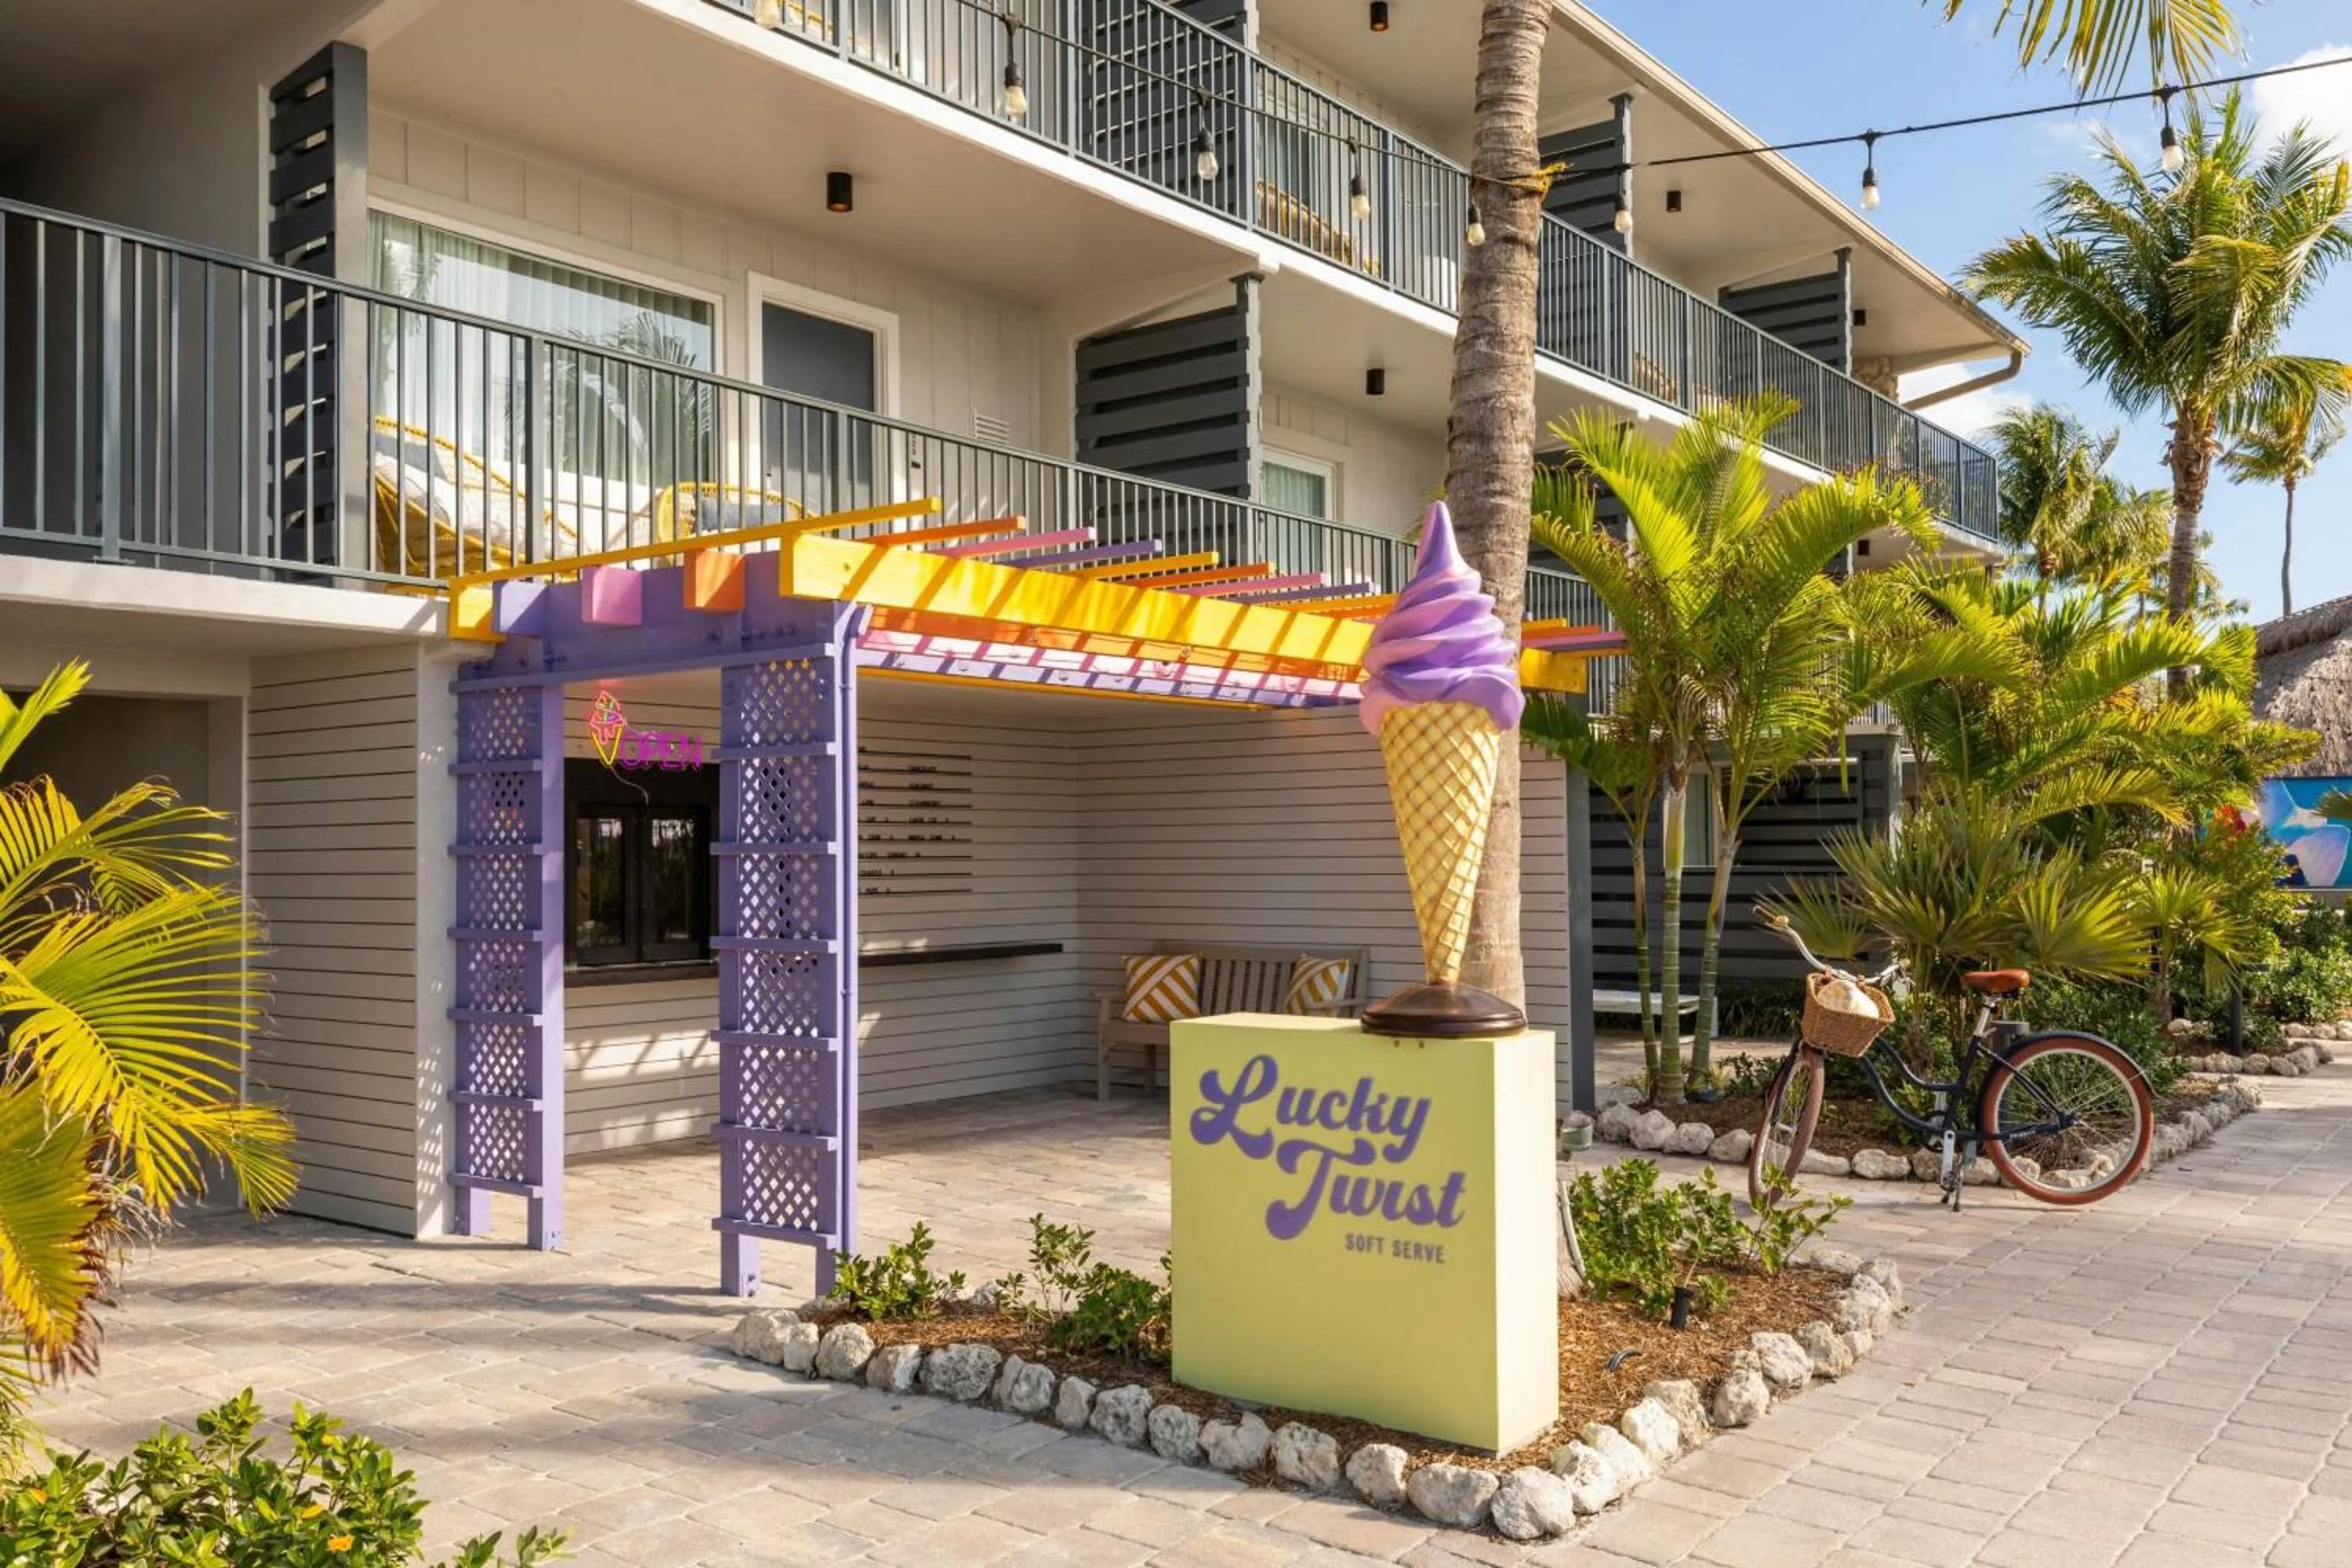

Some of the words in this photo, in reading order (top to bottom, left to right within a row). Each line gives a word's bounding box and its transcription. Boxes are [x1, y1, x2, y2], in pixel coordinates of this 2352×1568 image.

[619, 731, 703, 771] OPEN
[1190, 1054, 1432, 1163] Lucky
[1265, 1138, 1467, 1241] Twist
[1345, 1233, 1385, 1254] SOFT
[1392, 1241, 1446, 1265] SERVE
